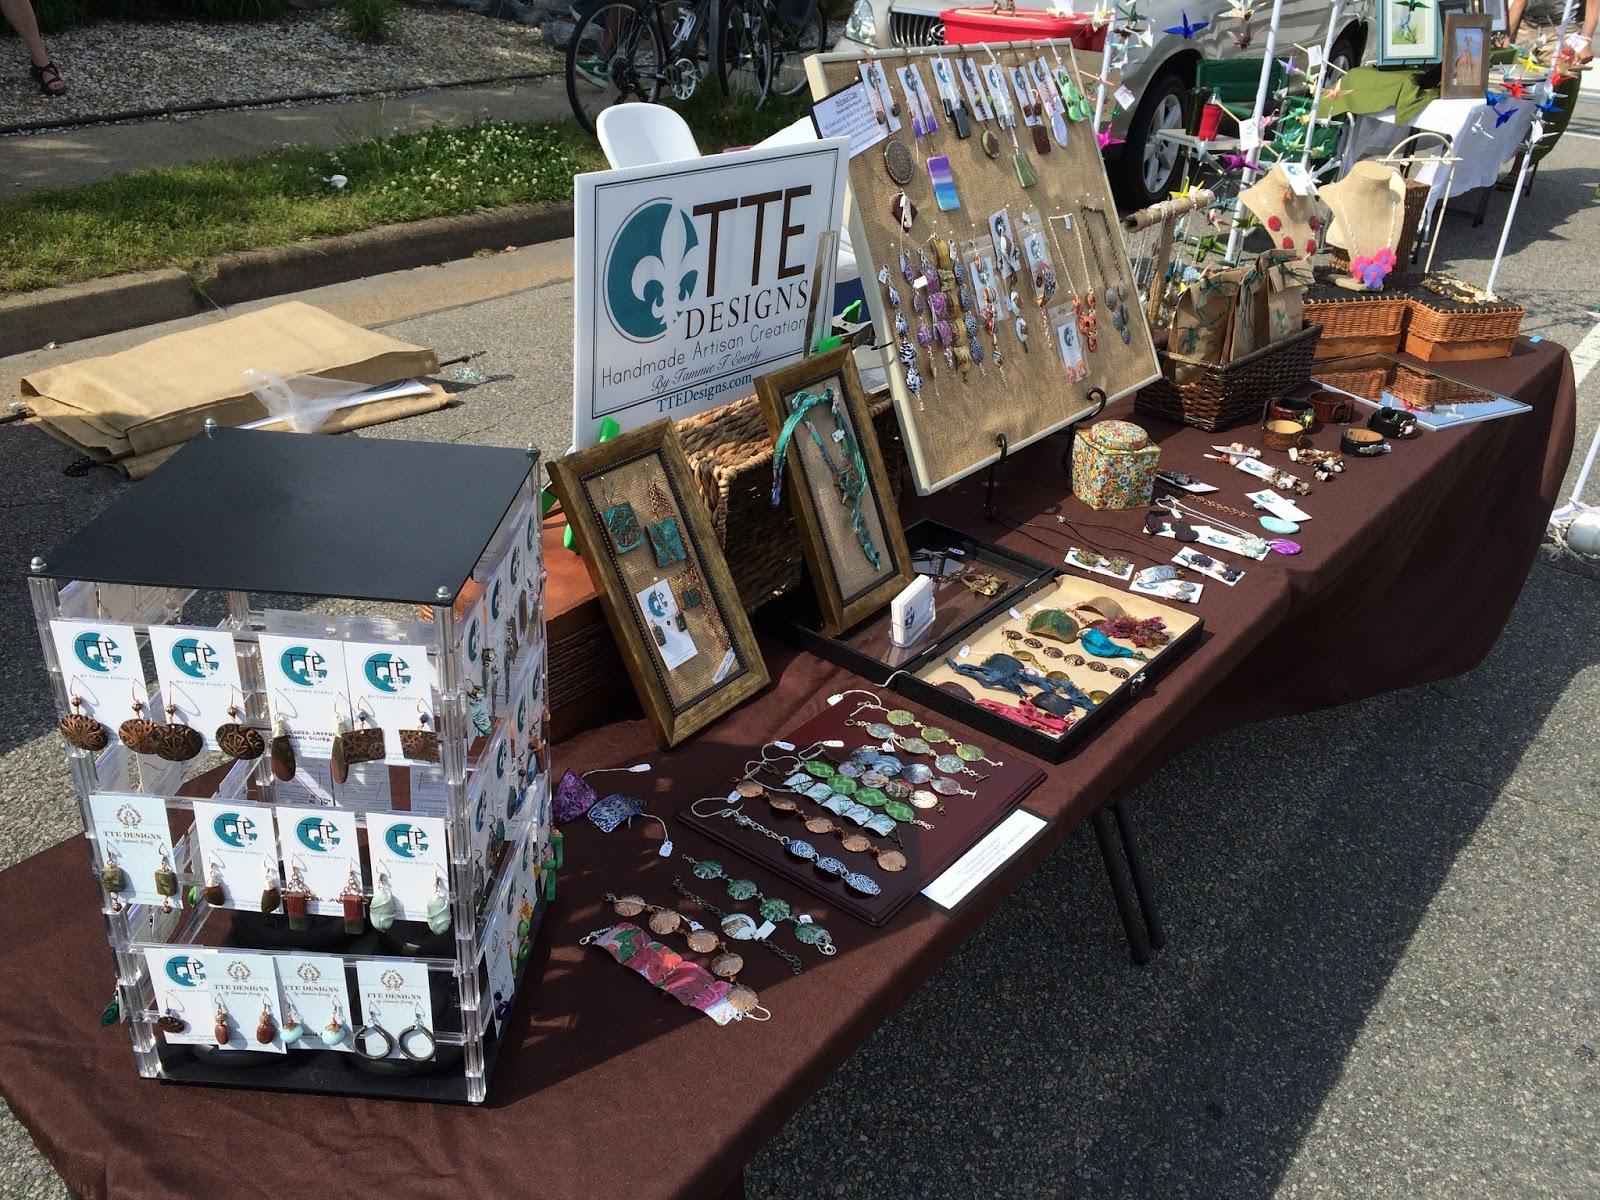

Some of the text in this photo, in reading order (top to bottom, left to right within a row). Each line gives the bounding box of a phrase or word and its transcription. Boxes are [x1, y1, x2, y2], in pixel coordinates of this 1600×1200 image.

[692, 185, 812, 298] TTE
[684, 280, 808, 340] DESIGNS
[602, 318, 814, 388] Handmade Artisan Creation
[652, 376, 670, 392] By
[672, 362, 716, 385] Tammie
[731, 346, 762, 366] Everly
[656, 373, 752, 412] TTEDesigns.com
[77, 639, 118, 657] TTE
[175, 645, 215, 664] TTE
[285, 653, 325, 671] TTE
[368, 660, 408, 677] TTE
[217, 818, 254, 834] TTE
[300, 822, 337, 839] TTE
[123, 832, 162, 840] DESIGNS
[389, 829, 426, 845] TTE
